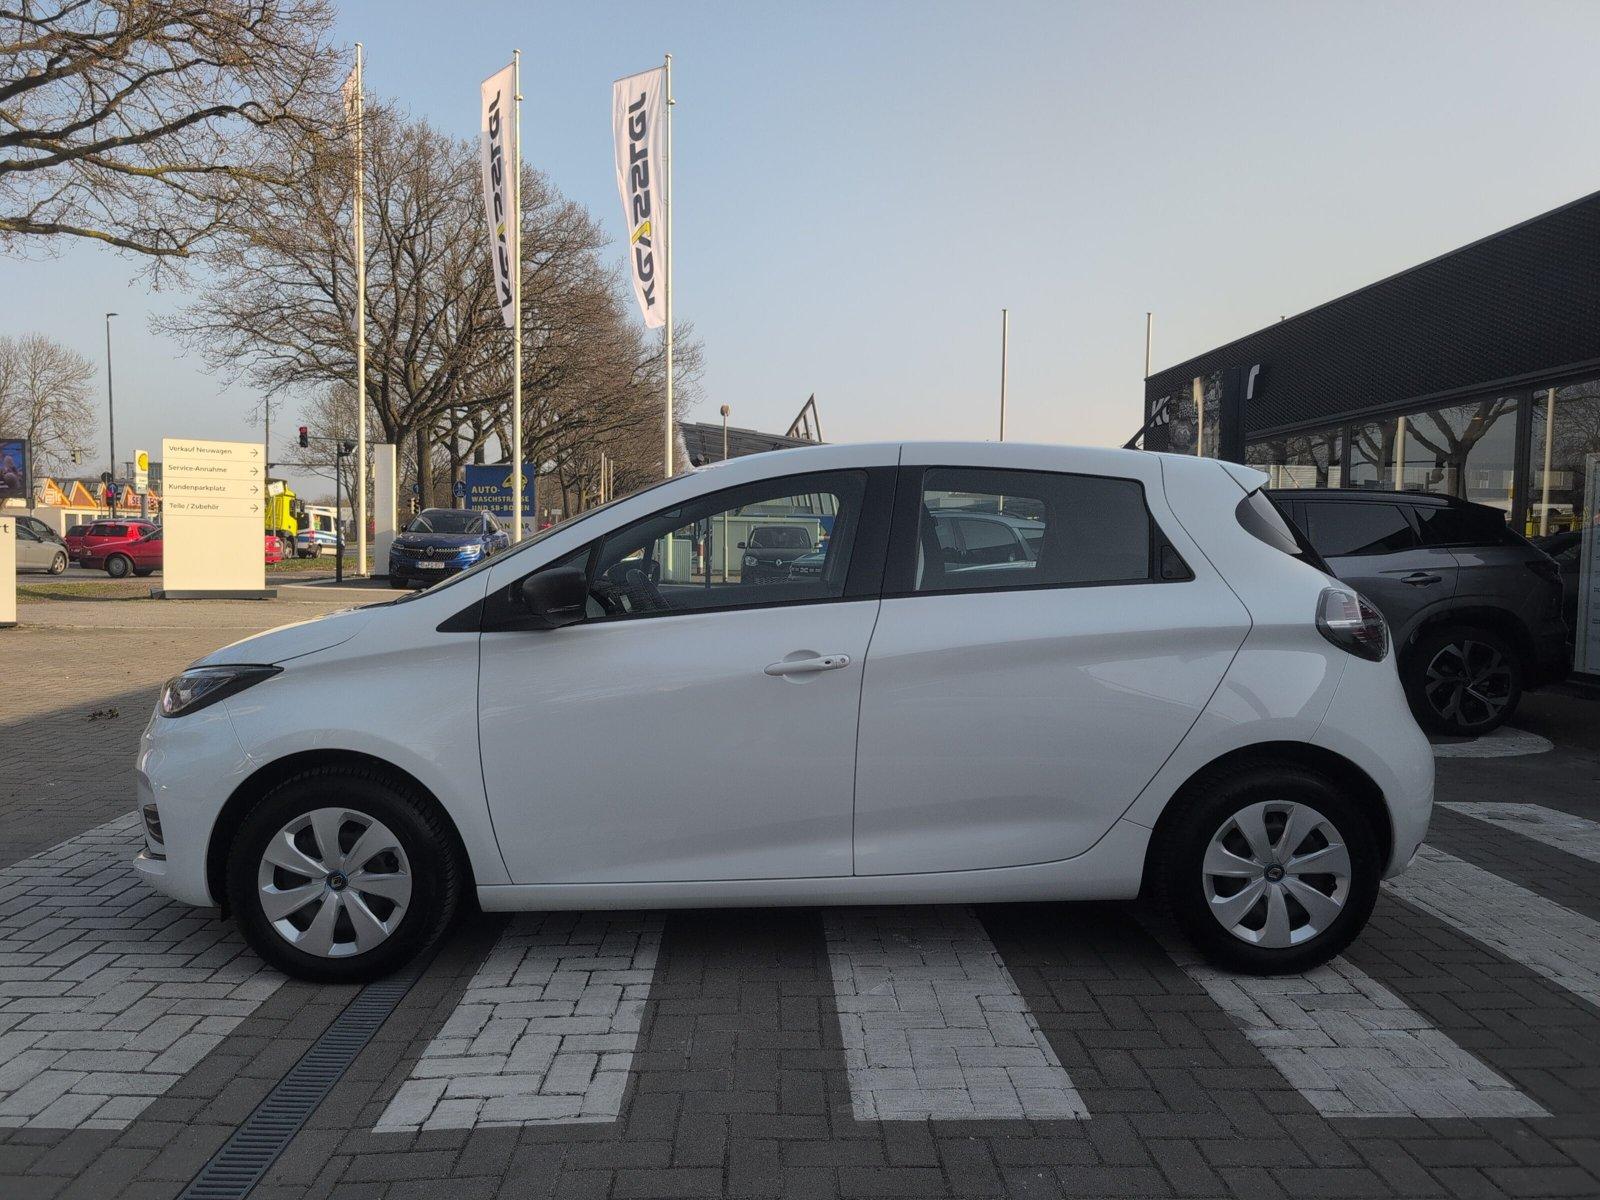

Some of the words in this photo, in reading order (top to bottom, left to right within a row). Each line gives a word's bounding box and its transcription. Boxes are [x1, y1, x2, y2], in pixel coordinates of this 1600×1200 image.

[196, 447, 233, 455] Neuwagen
[168, 464, 228, 473] Service-Annahme
[168, 483, 226, 492] Kundenparkplatz
[472, 486, 500, 494] AUTO-
